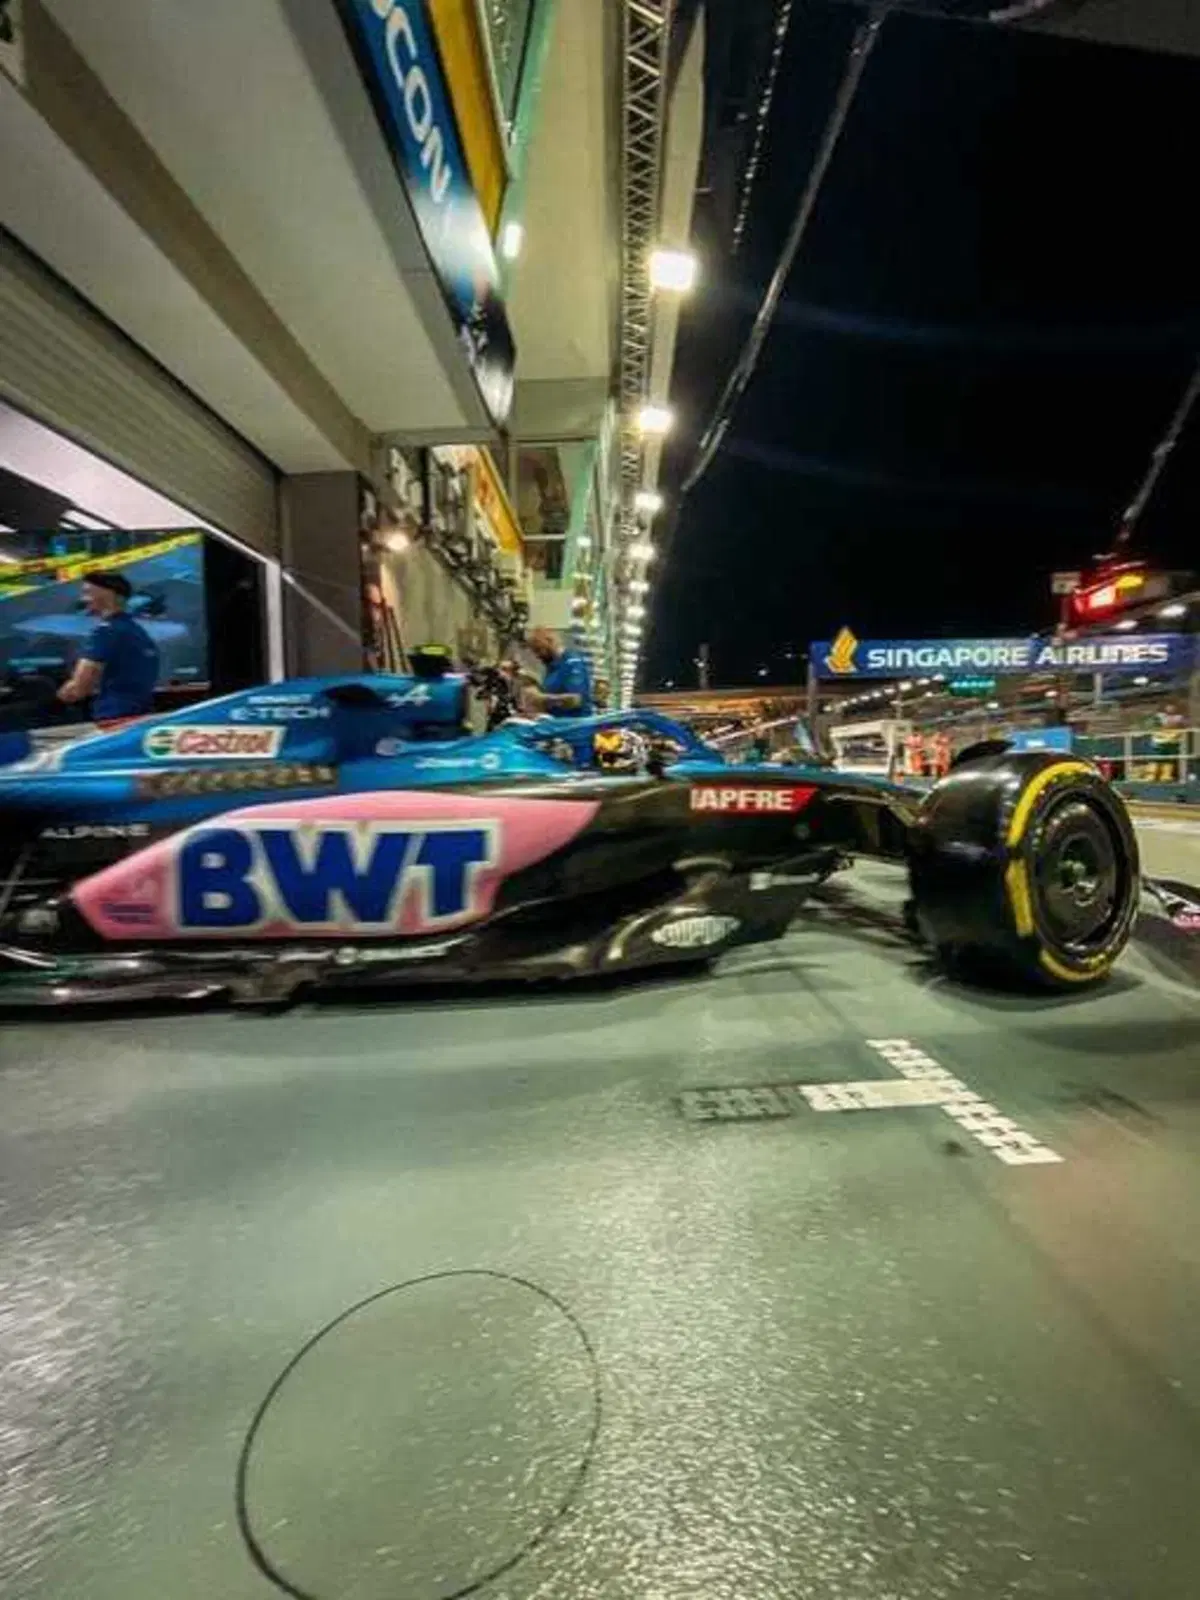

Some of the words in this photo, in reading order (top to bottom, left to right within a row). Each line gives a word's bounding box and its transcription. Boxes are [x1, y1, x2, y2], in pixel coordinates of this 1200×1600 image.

[372, 0, 452, 204] CON
[867, 647, 1029, 668] SINGAPORE
[177, 825, 492, 931] BWT
